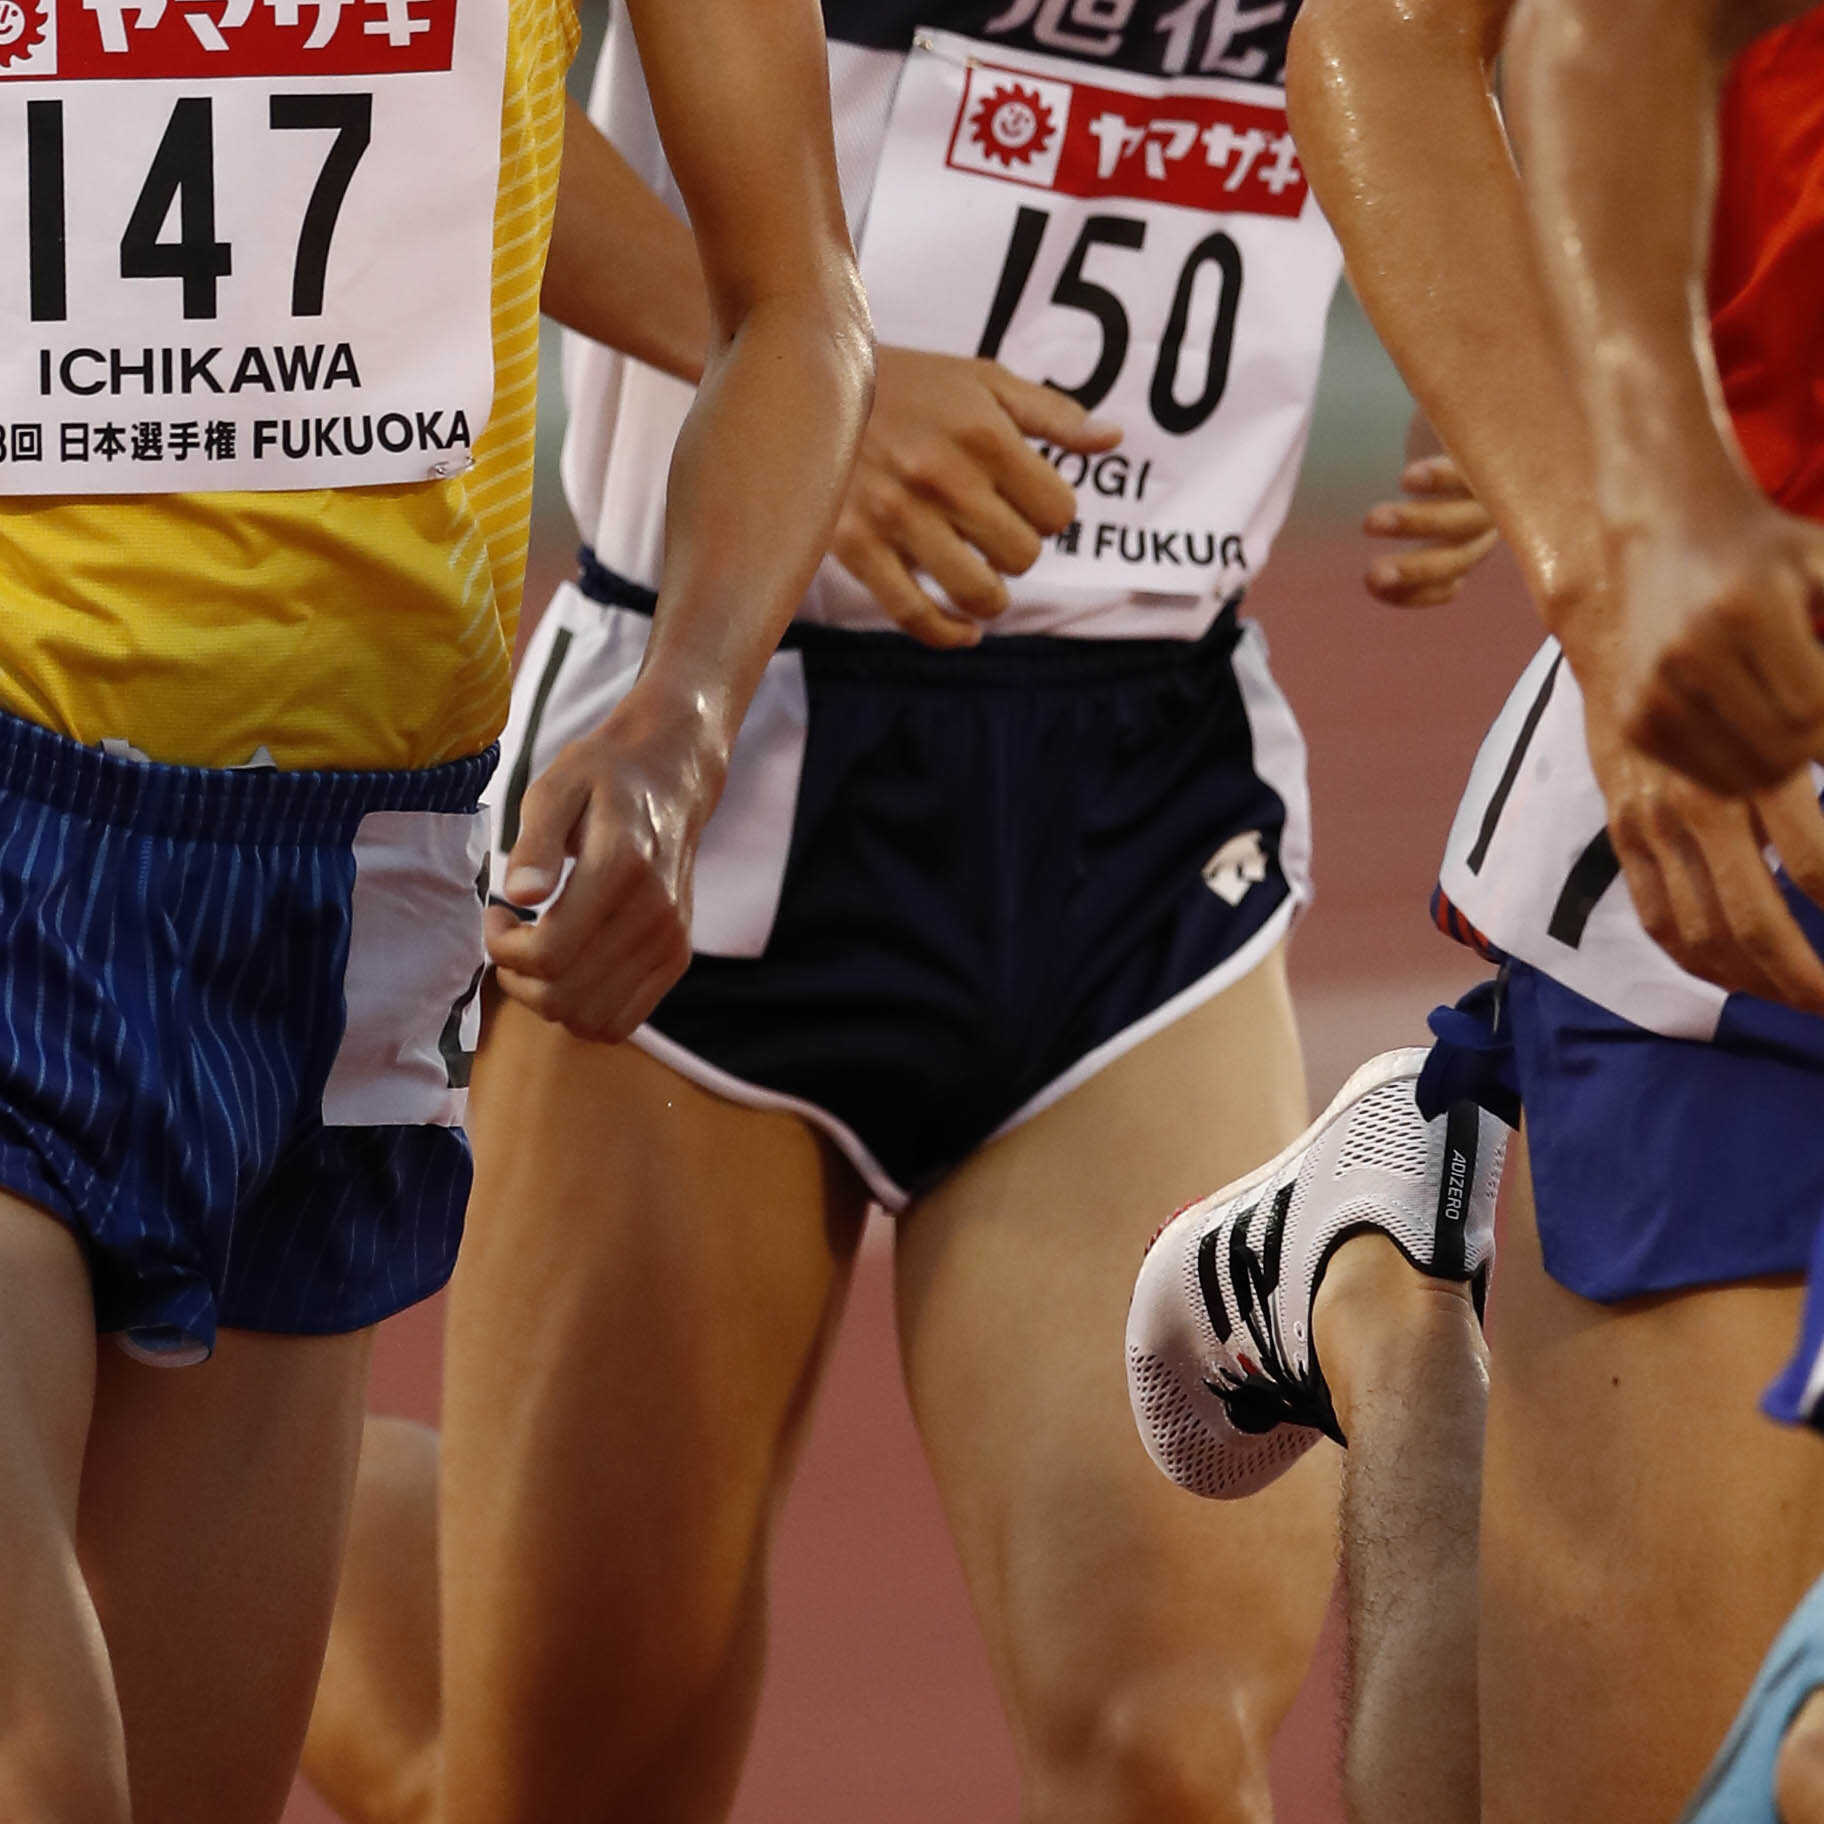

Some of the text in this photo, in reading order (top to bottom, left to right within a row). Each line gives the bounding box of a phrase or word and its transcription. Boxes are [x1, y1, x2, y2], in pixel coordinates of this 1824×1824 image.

[1088, 112, 1301, 195] ヤマザキ
[26, 91, 373, 323] 147
[978, 206, 1243, 435] 150
[40, 343, 361, 397] ICHIKAWA
[60, 421, 237, 462] 日本選手権
[253, 410, 472, 460] FUKUOKA
[1039, 444, 1152, 501] OGI
[1444, 1148, 1468, 1221] ADIZERO
